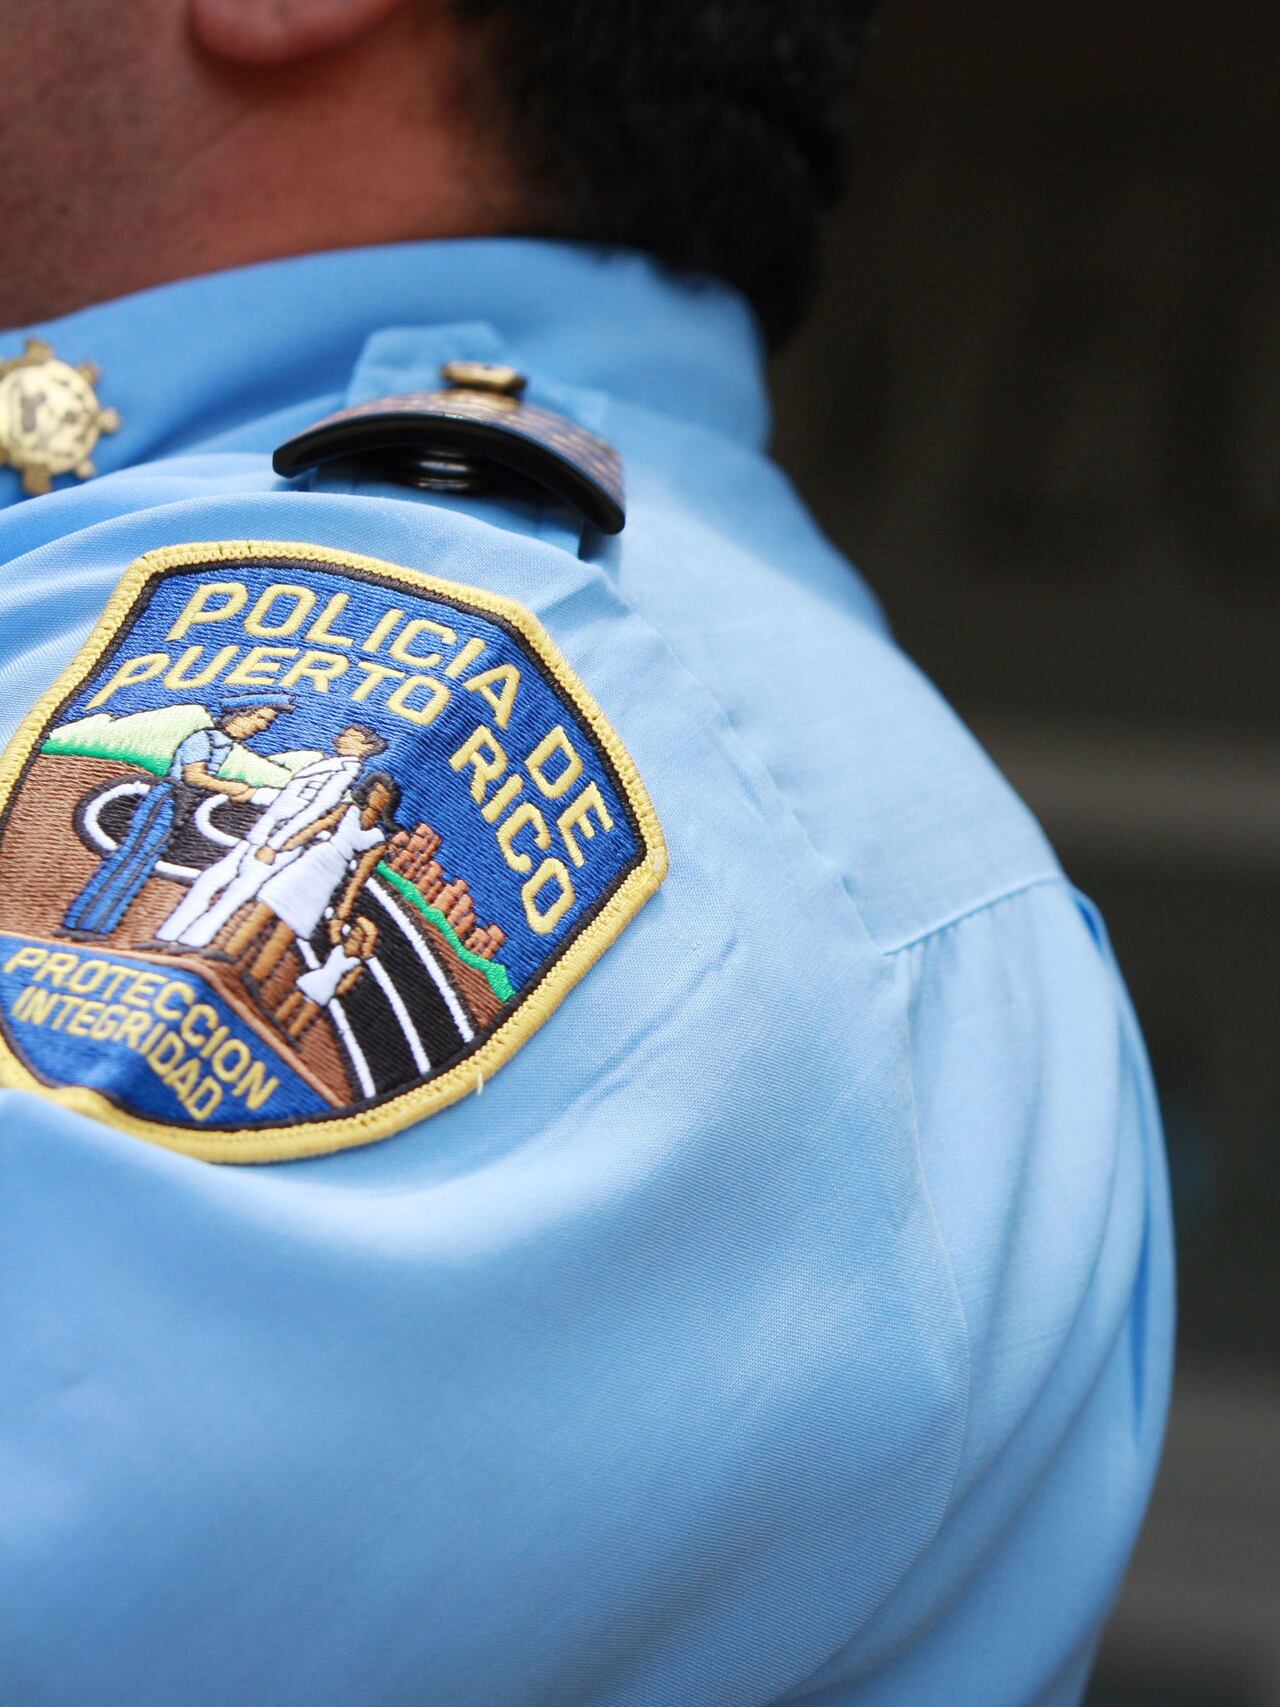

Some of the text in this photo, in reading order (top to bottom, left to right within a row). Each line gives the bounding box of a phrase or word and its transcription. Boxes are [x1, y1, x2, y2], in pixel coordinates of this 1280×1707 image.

[85, 645, 576, 935] PUERTO RICO
[164, 582, 614, 868] POLICIA DE
[3, 947, 280, 1110] PROTECCION
[11, 985, 223, 1121] INTEGRIDAD
